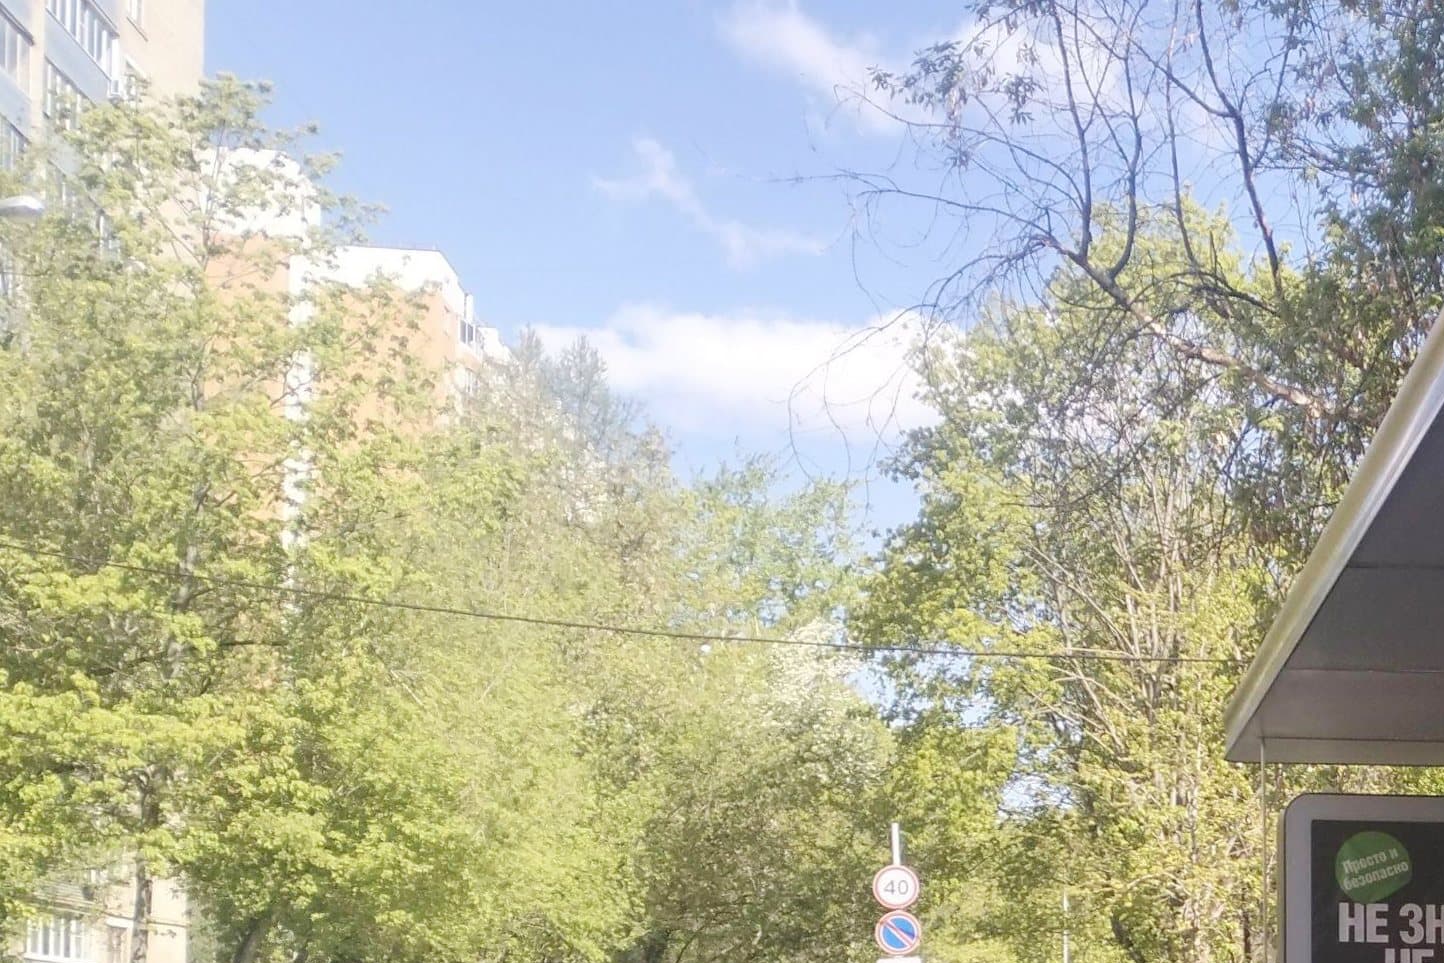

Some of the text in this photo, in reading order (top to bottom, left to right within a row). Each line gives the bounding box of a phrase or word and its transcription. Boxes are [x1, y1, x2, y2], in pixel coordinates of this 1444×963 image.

[1342, 848, 1399, 874] Просто и
[883, 879, 909, 895] 40
[1343, 862, 1409, 890] безопасно
[1338, 903, 1389, 943] НЕ
